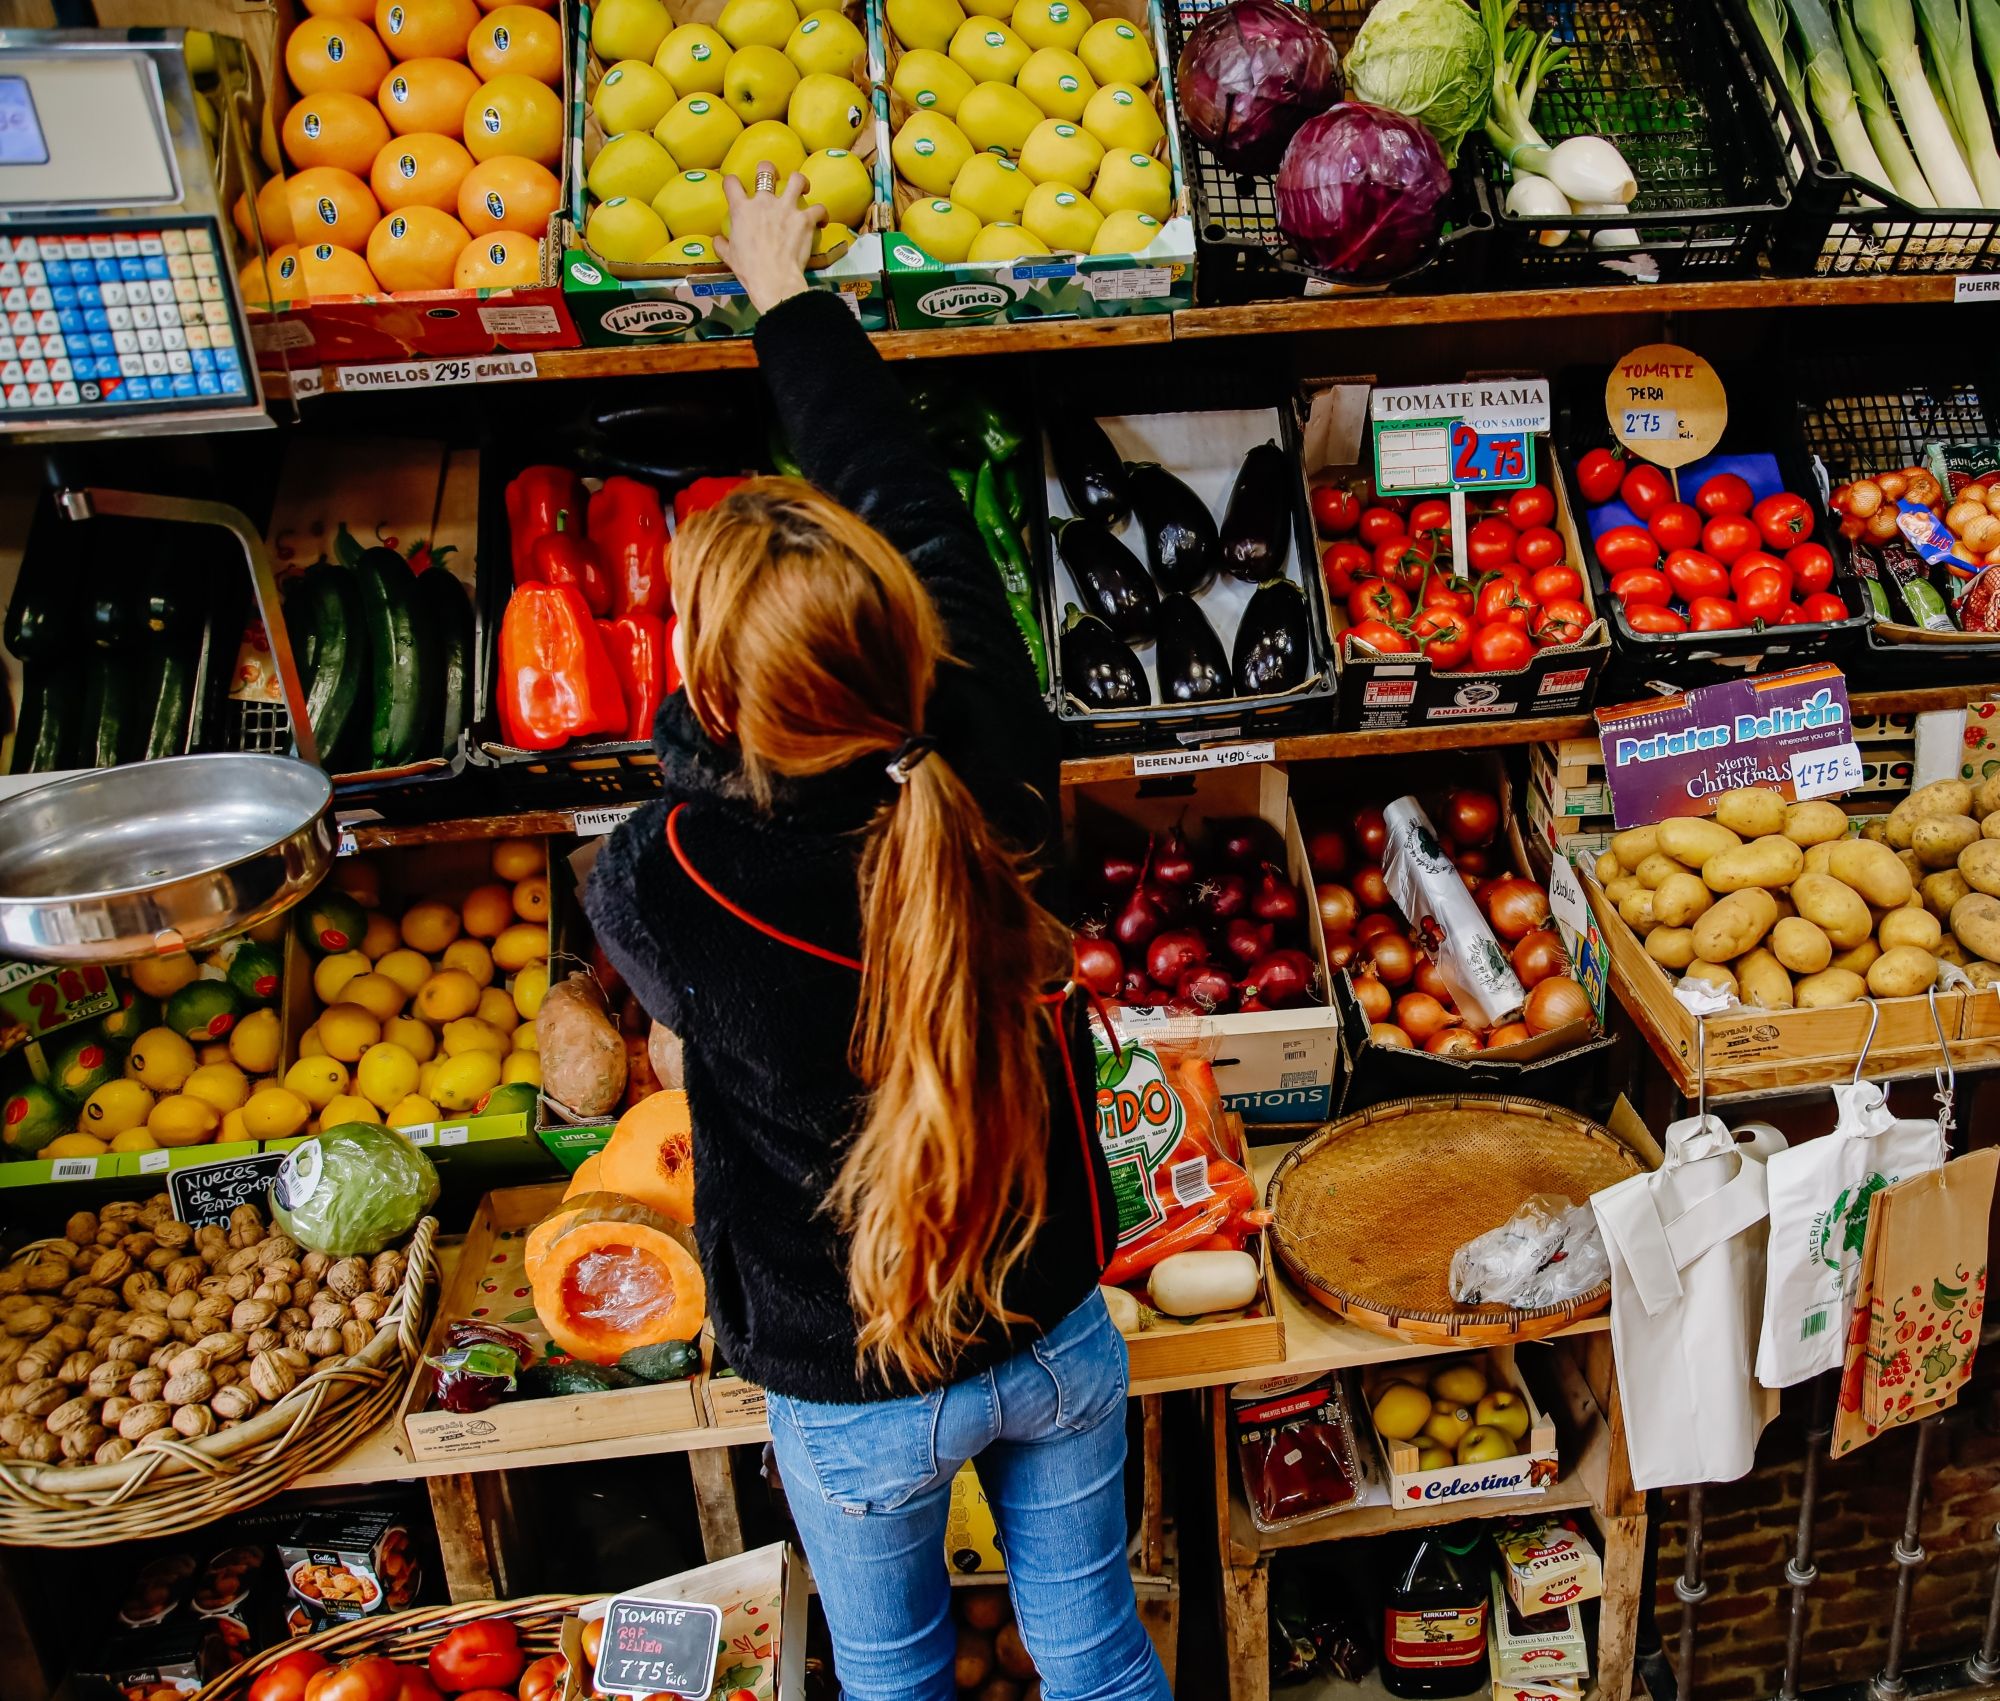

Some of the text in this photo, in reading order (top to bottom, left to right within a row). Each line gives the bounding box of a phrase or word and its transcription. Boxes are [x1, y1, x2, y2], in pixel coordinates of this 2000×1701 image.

[928, 292, 1002, 315] Livinda
[613, 309, 686, 332] Livinda
[344, 368, 430, 386] POMELOS
[477, 360, 534, 376] €/KILO
[1621, 362, 1695, 379] TOMATE
[1383, 388, 1545, 412] TOMATE RAMA
[1626, 386, 1664, 401] PERA
[1617, 725, 1730, 766] Patatas
[1778, 730, 1836, 747] Wherever you are
[1136, 753, 1209, 768] BERENJENA
[1715, 755, 1758, 774] Merry
[1686, 761, 1792, 799] Christmas
[576, 813, 627, 825] PIMIENTO
[68, 1000, 113, 1021] KILO
[190, 1191, 216, 1205] de
[198, 1196, 246, 1217] RADA
[1809, 1210, 1827, 1266] MATERIAL
[1259, 1380, 1281, 1390] CAMPO
[1425, 1474, 1524, 1500] Celestino
[617, 1608, 687, 1626] TOMATE
[1423, 1610, 1458, 1618] KIRKLAND
[617, 1626, 648, 1640] RAF
